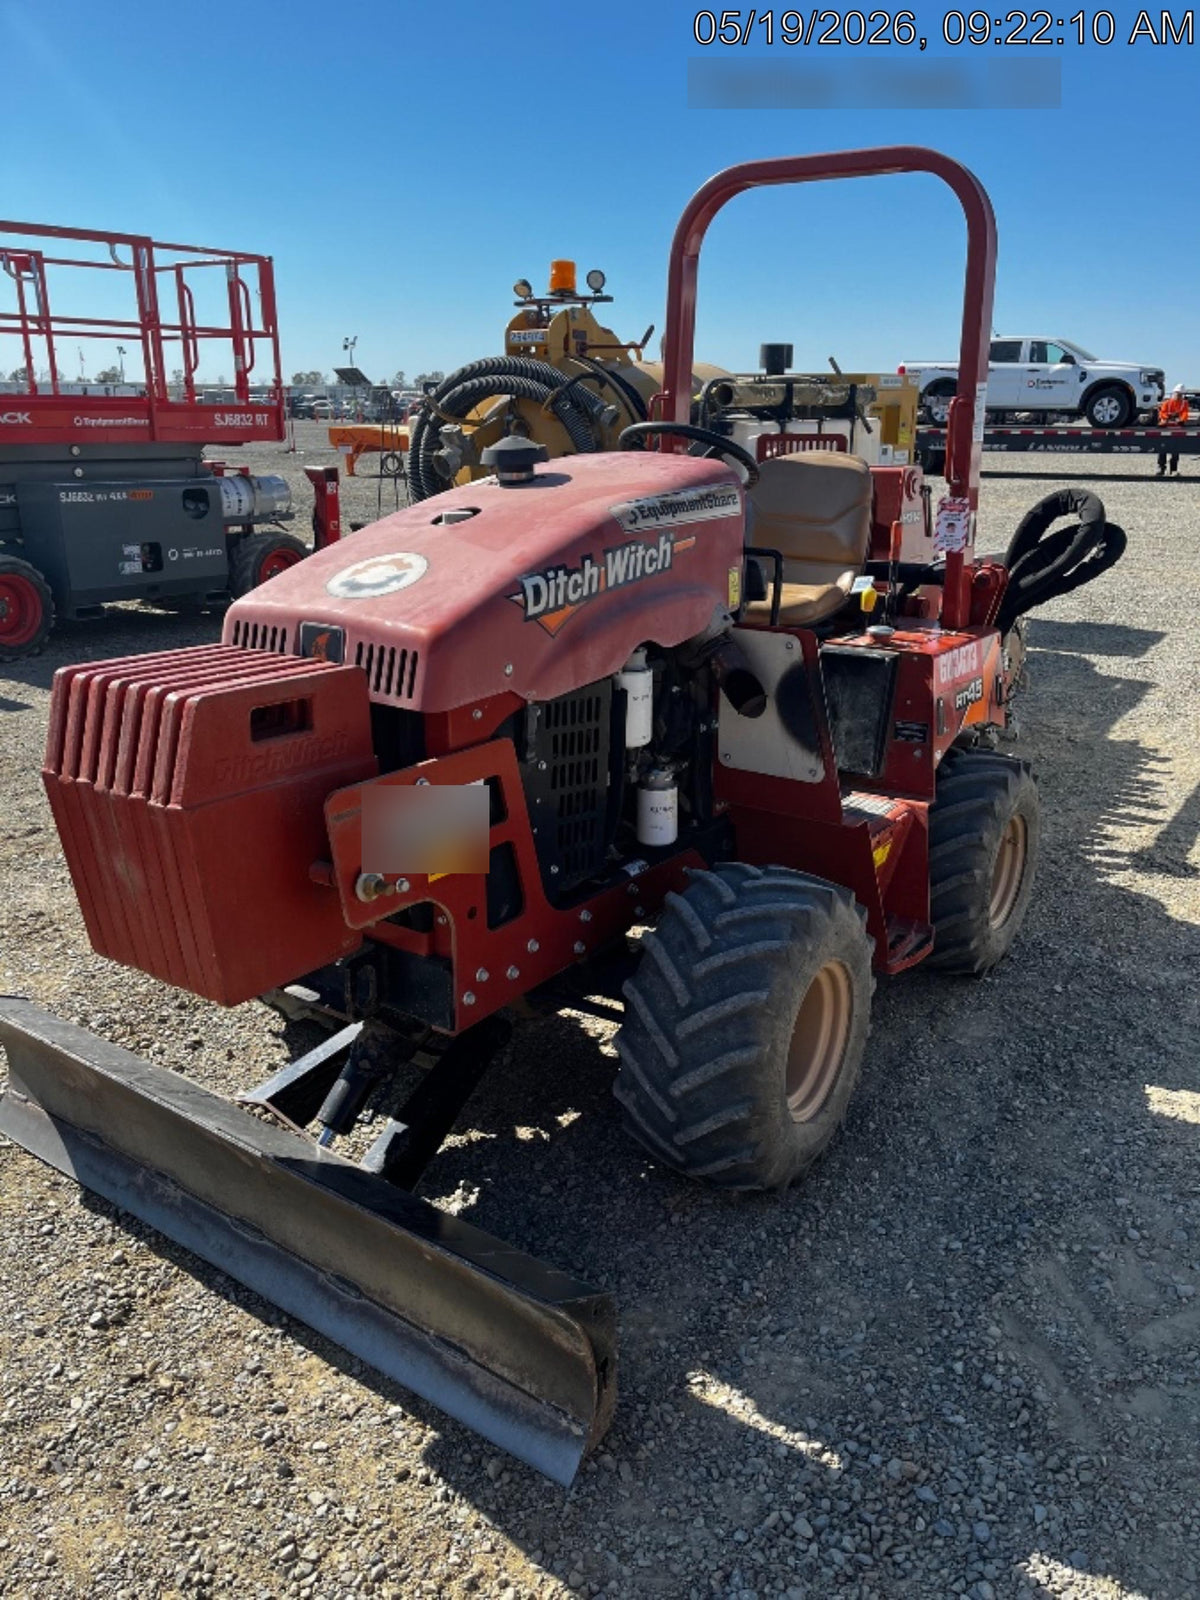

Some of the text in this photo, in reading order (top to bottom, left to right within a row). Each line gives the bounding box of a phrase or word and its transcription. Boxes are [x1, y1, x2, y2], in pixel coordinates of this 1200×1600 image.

[214, 412, 269, 426] SJ6832 RT
[639, 493, 739, 521] EquipmentShare
[522, 535, 673, 617] Ditch Witch
[956, 678, 983, 709] RT45
